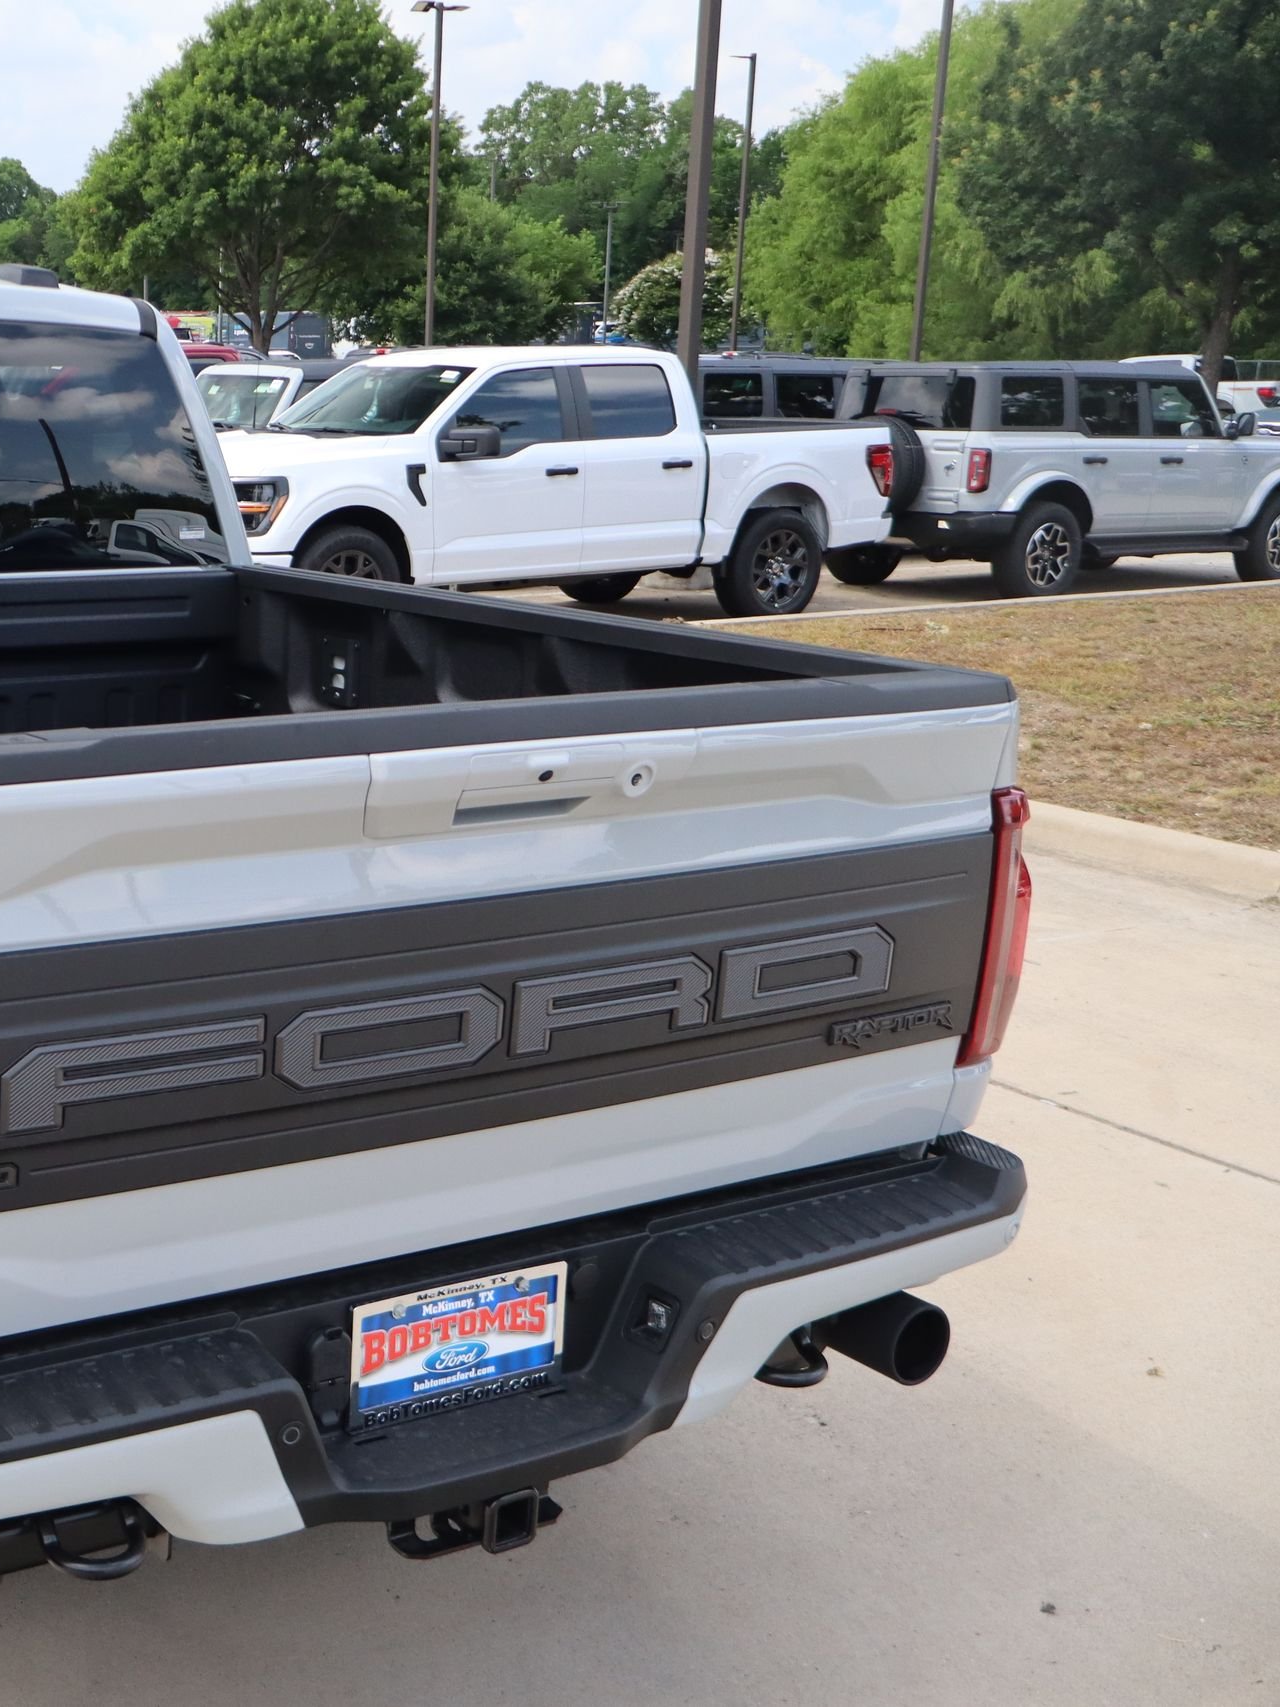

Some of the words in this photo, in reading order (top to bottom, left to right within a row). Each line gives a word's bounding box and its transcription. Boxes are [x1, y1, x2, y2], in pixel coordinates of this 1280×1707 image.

[828, 1000, 953, 1048] RAPTOR
[416, 1281, 486, 1302] McKinney,
[490, 1275, 508, 1285] TX
[422, 1297, 475, 1316] McKinney,
[479, 1290, 495, 1303] TX
[413, 1364, 496, 1392] bobtomesford.com
[363, 1371, 550, 1428] BobTomesFord.com
